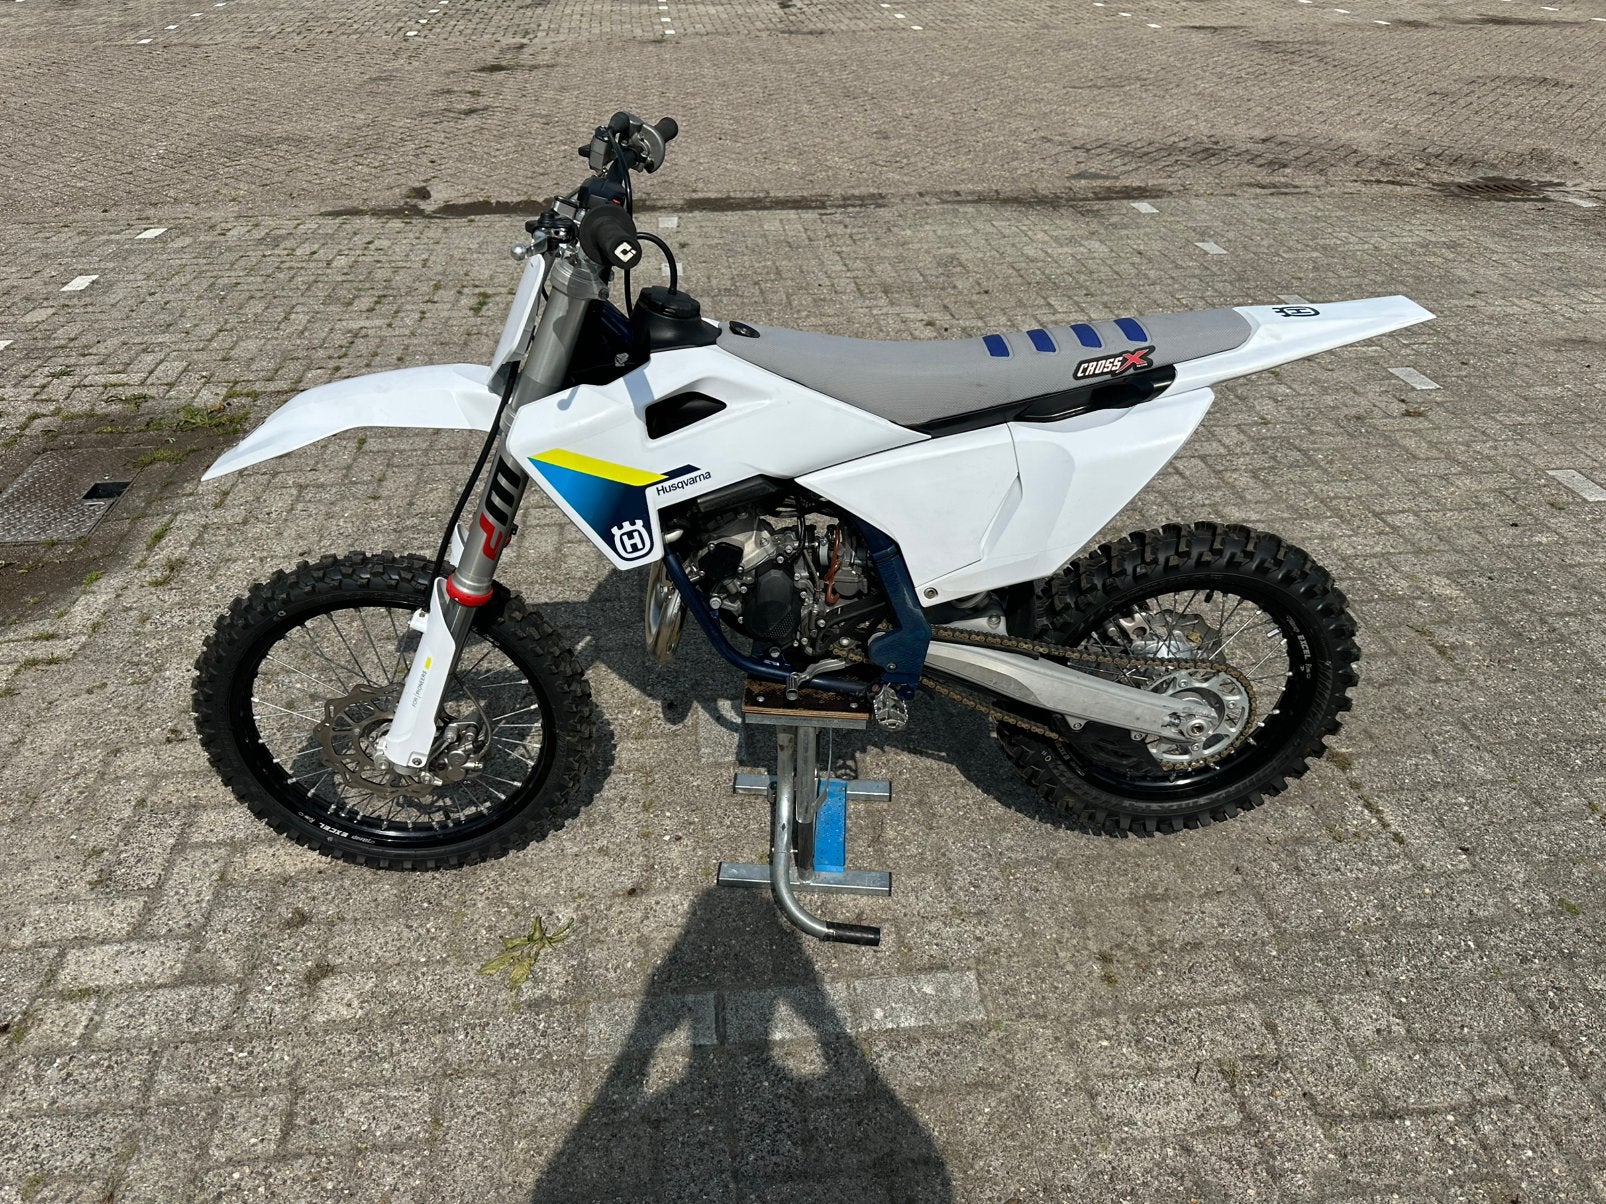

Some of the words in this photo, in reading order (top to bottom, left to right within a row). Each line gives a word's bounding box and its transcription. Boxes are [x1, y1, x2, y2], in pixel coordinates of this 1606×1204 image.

[656, 471, 712, 496] Husqvarna
[479, 454, 521, 561] WP
[1297, 634, 1311, 660] EXCEL
[415, 670, 427, 696] PIONEERS
[319, 822, 349, 838] EXCEL
